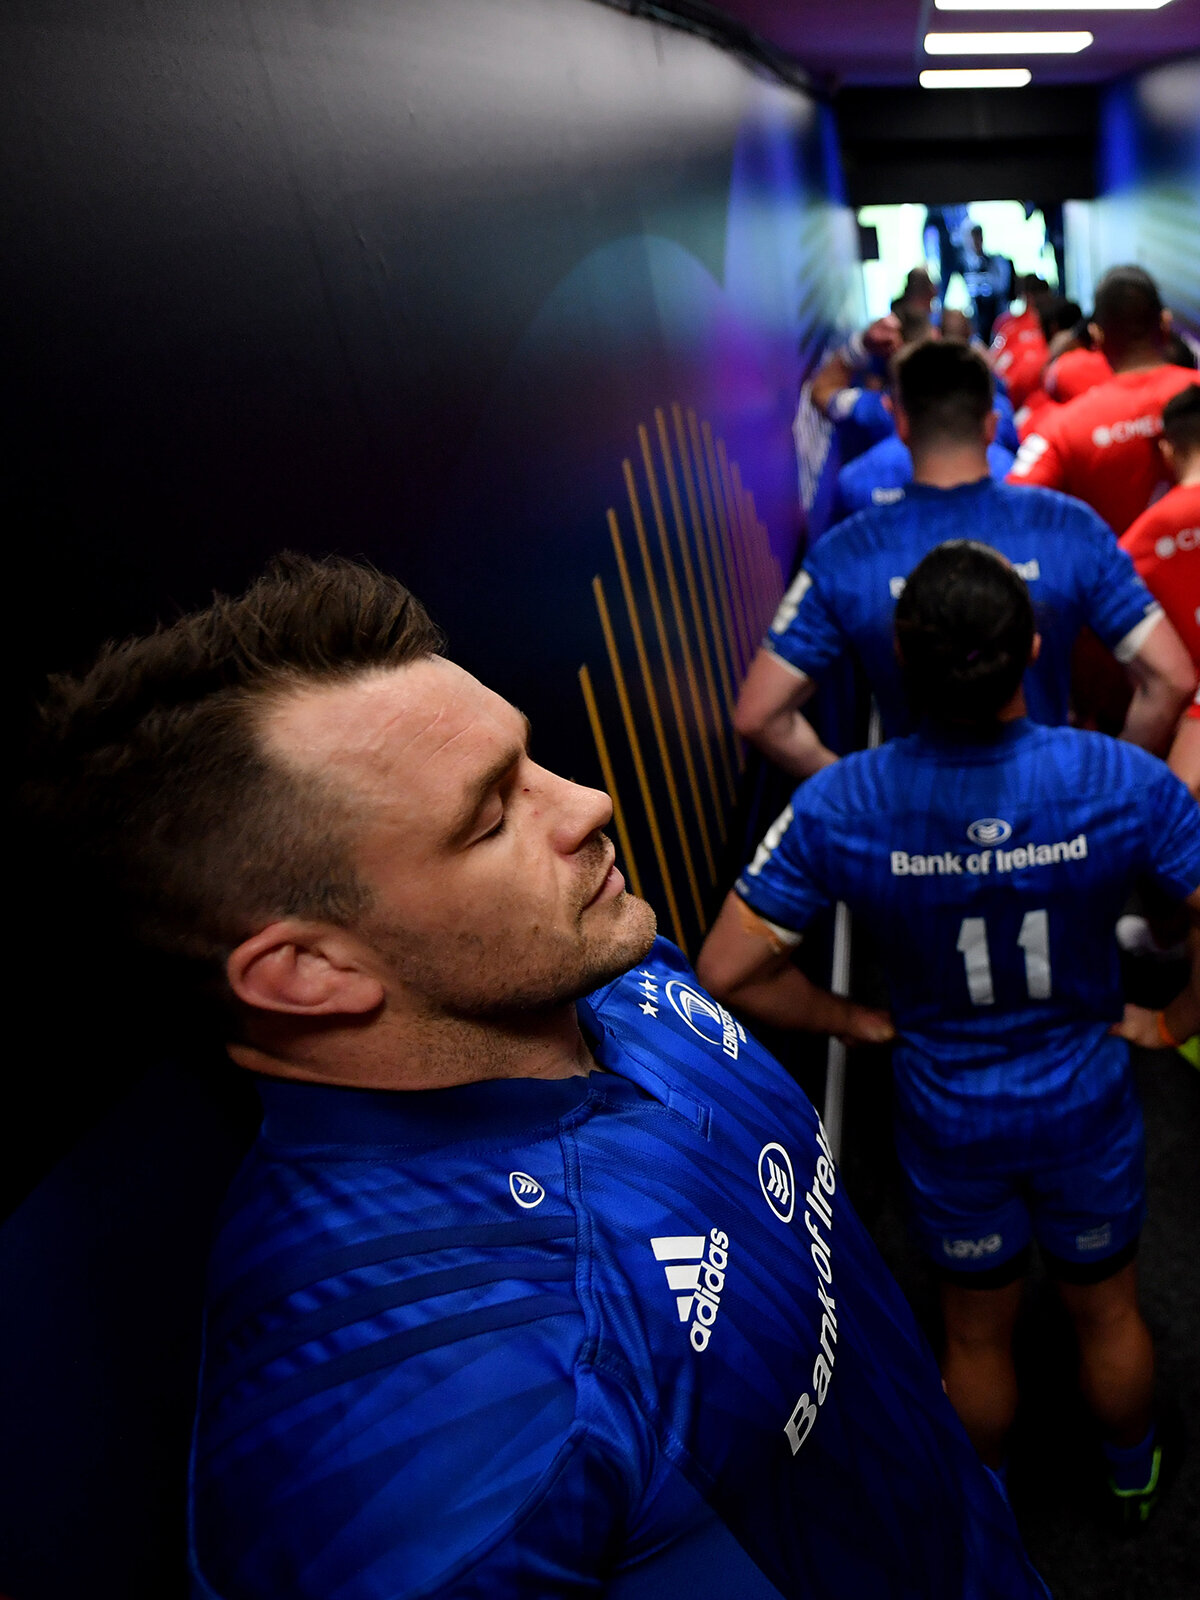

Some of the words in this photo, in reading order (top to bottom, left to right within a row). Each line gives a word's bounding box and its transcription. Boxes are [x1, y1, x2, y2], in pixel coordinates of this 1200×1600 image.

[891, 851, 962, 876] Bank
[967, 851, 992, 875] of
[996, 834, 1088, 872] Ireland
[957, 909, 1052, 1005] 11
[690, 1228, 729, 1352] adidas
[805, 1210, 832, 1285] of
[784, 1276, 837, 1456] Bank
